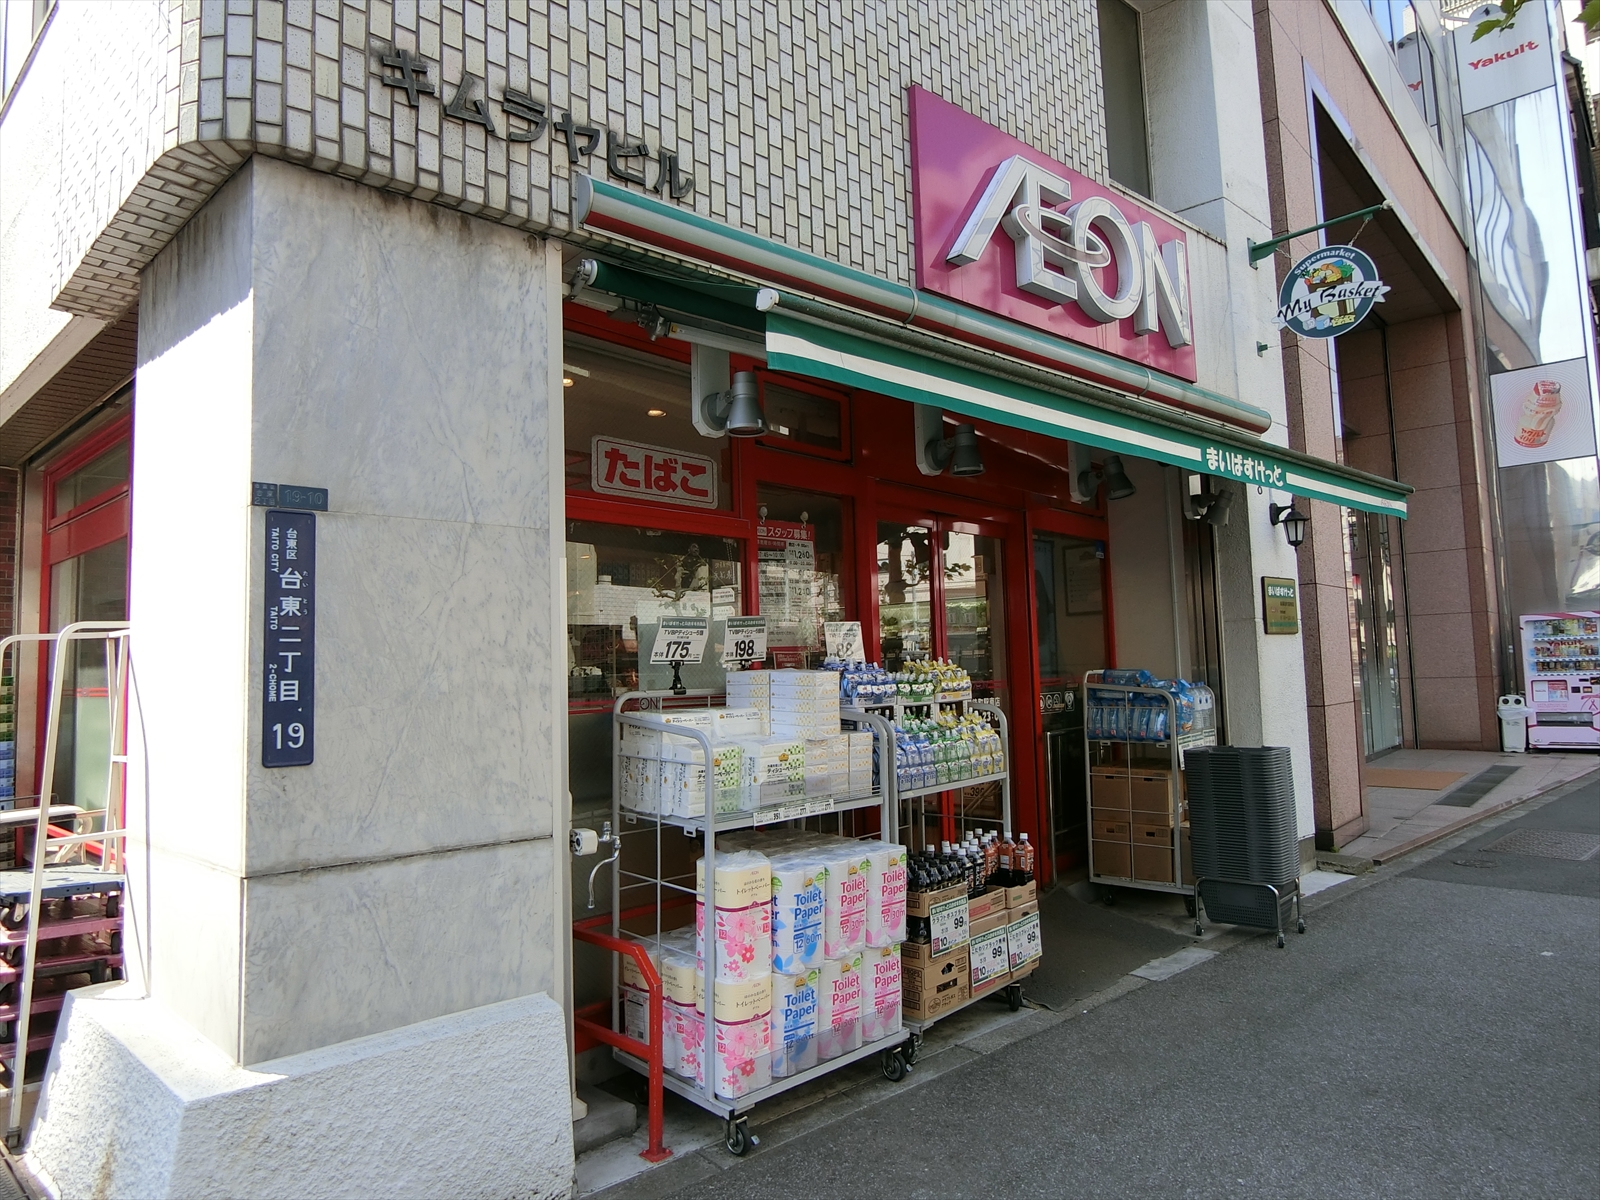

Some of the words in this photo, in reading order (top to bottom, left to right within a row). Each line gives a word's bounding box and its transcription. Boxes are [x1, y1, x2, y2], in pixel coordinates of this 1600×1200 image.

[1468, 40, 1540, 70] Yakult
[382, 49, 693, 198] キムラヤビル
[1294, 248, 1356, 275] Supermarket
[1277, 298, 1312, 321] My
[1319, 281, 1380, 303] Basket
[604, 447, 708, 498] たばこ
[1206, 447, 1284, 487] まいばすけっと
[285, 489, 325, 505] 19-10
[271, 527, 280, 551] TAITO
[286, 527, 298, 560] 台東区
[270, 553, 280, 573] CITY
[269, 606, 279, 631] TAITO
[279, 567, 303, 702] 台東二丁目
[1546, 639, 1584, 647] Yakult
[665, 640, 692, 659] 175
[734, 639, 755, 658] 198
[268, 663, 278, 703] 2-CHOME
[982, 711, 999, 722] 23:0
[272, 722, 305, 750] 19
[882, 869, 906, 884] Toilet
[841, 879, 866, 894] Toilet
[882, 883, 906, 897] Paper
[793, 889, 822, 907] Toilet
[841, 889, 868, 908] Paper
[794, 904, 823, 921] Paper
[953, 915, 964, 930] 99
[1026, 931, 1036, 944] 99
[992, 945, 1003, 959] 99
[873, 958, 900, 976] Toilet
[831, 974, 860, 992] Toilet
[874, 972, 901, 989] Paper
[784, 988, 815, 1007] Toilet
[832, 988, 861, 1006] Paper
[784, 1003, 816, 1021] Paper
